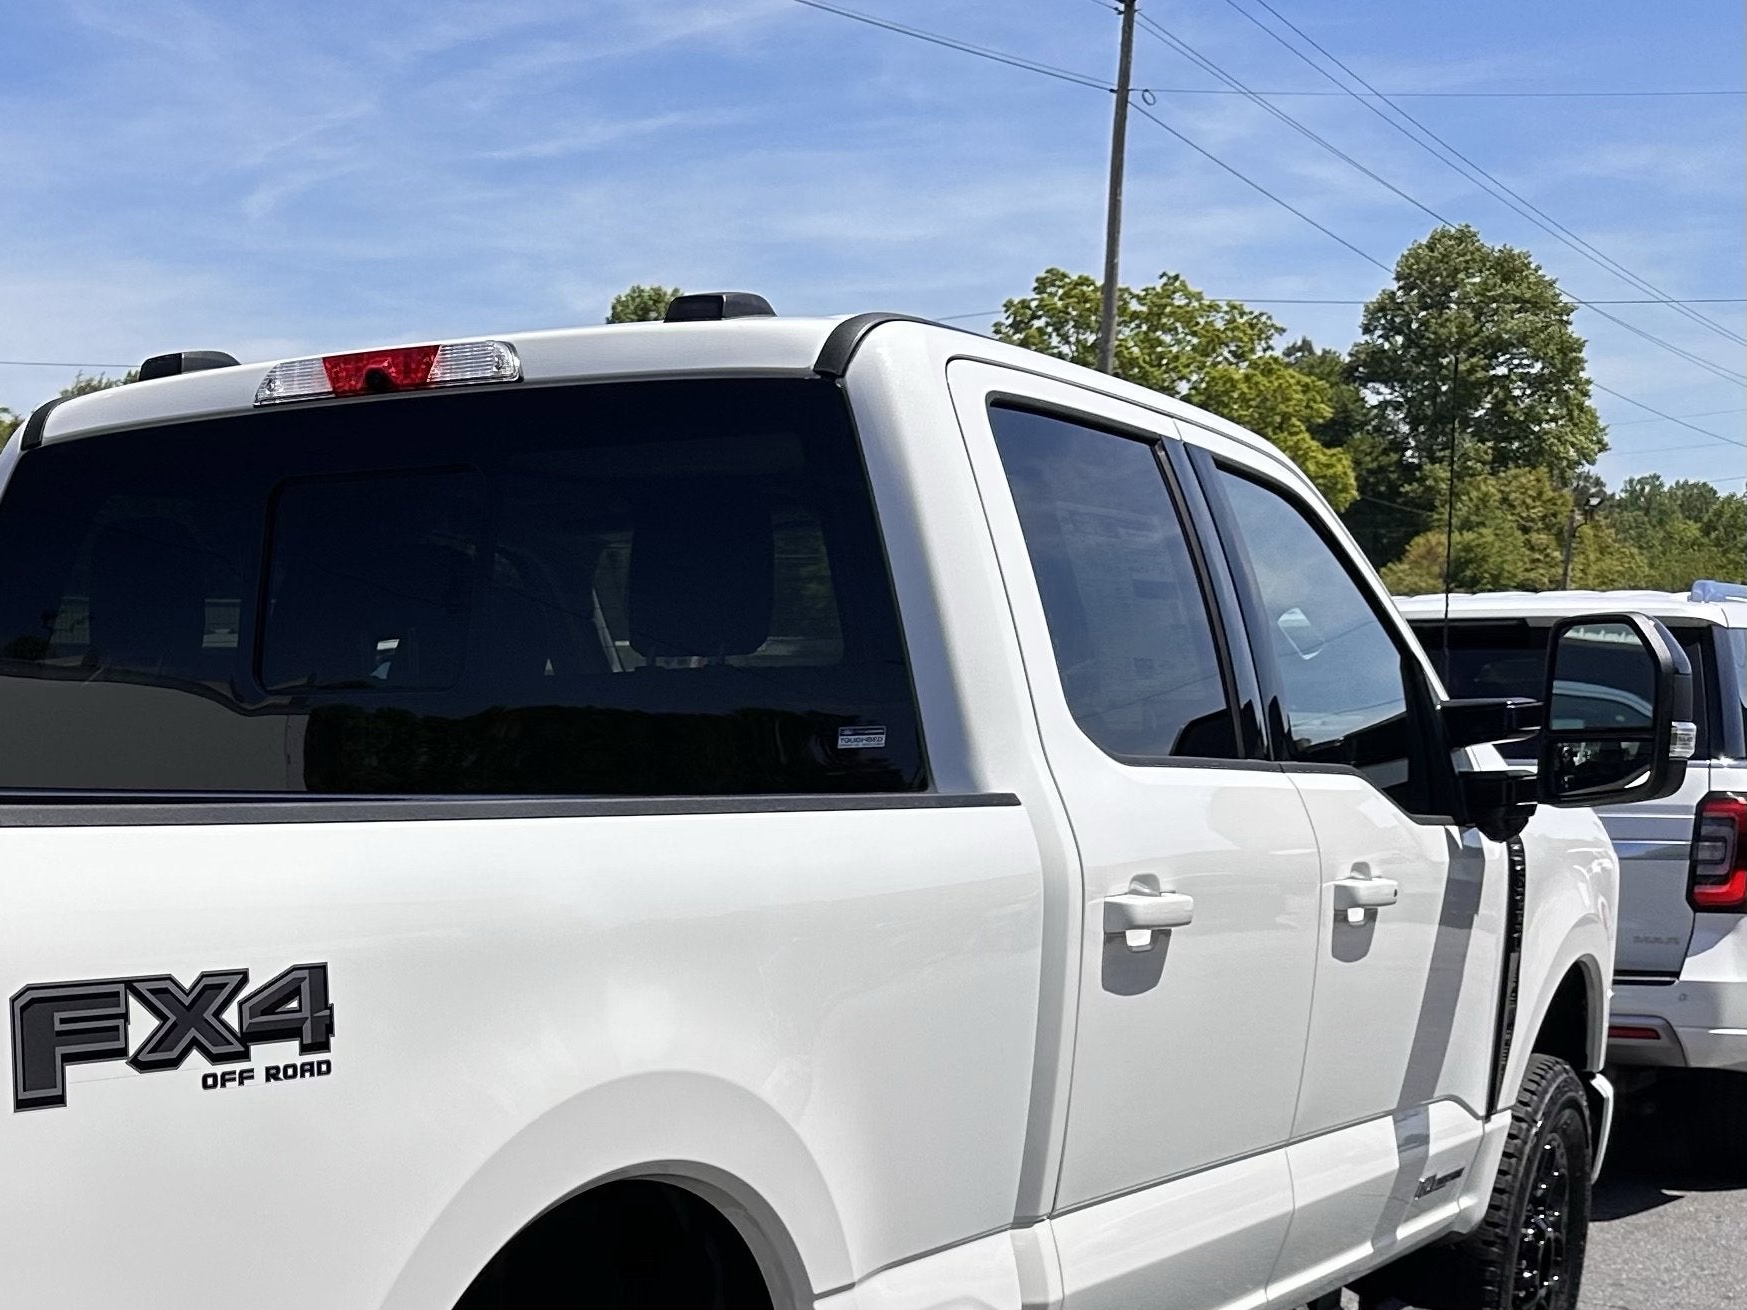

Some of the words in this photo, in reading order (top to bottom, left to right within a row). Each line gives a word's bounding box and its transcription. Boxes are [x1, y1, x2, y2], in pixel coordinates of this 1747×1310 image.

[9, 962, 335, 1113] FX4
[202, 1067, 255, 1090] OFF
[265, 1059, 332, 1083] ROAD
